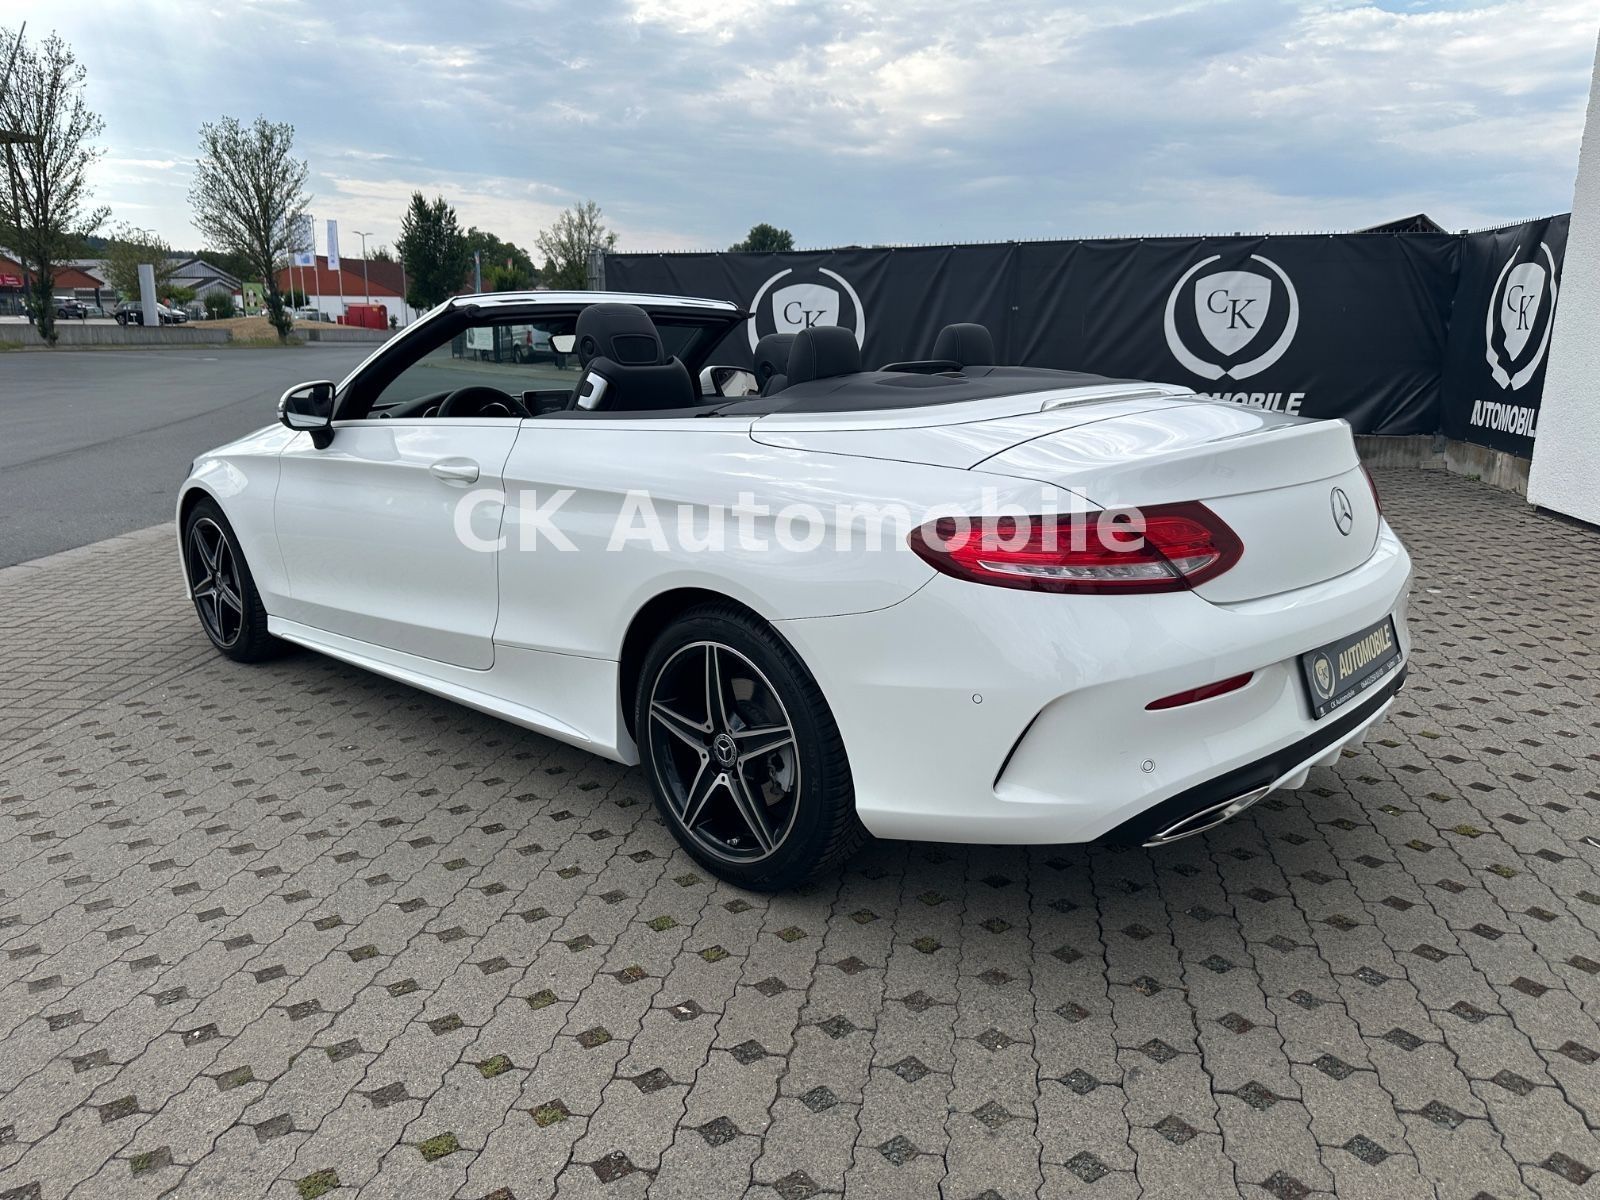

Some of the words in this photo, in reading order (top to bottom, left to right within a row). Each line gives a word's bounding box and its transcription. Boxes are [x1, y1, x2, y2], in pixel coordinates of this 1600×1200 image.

[1207, 289, 1257, 329] CK
[1507, 284, 1535, 330] CK
[1199, 392, 1306, 416] BILE
[1470, 400, 1536, 438] AUTOMOBIL
[1339, 623, 1392, 680] AUTOMOBILE
